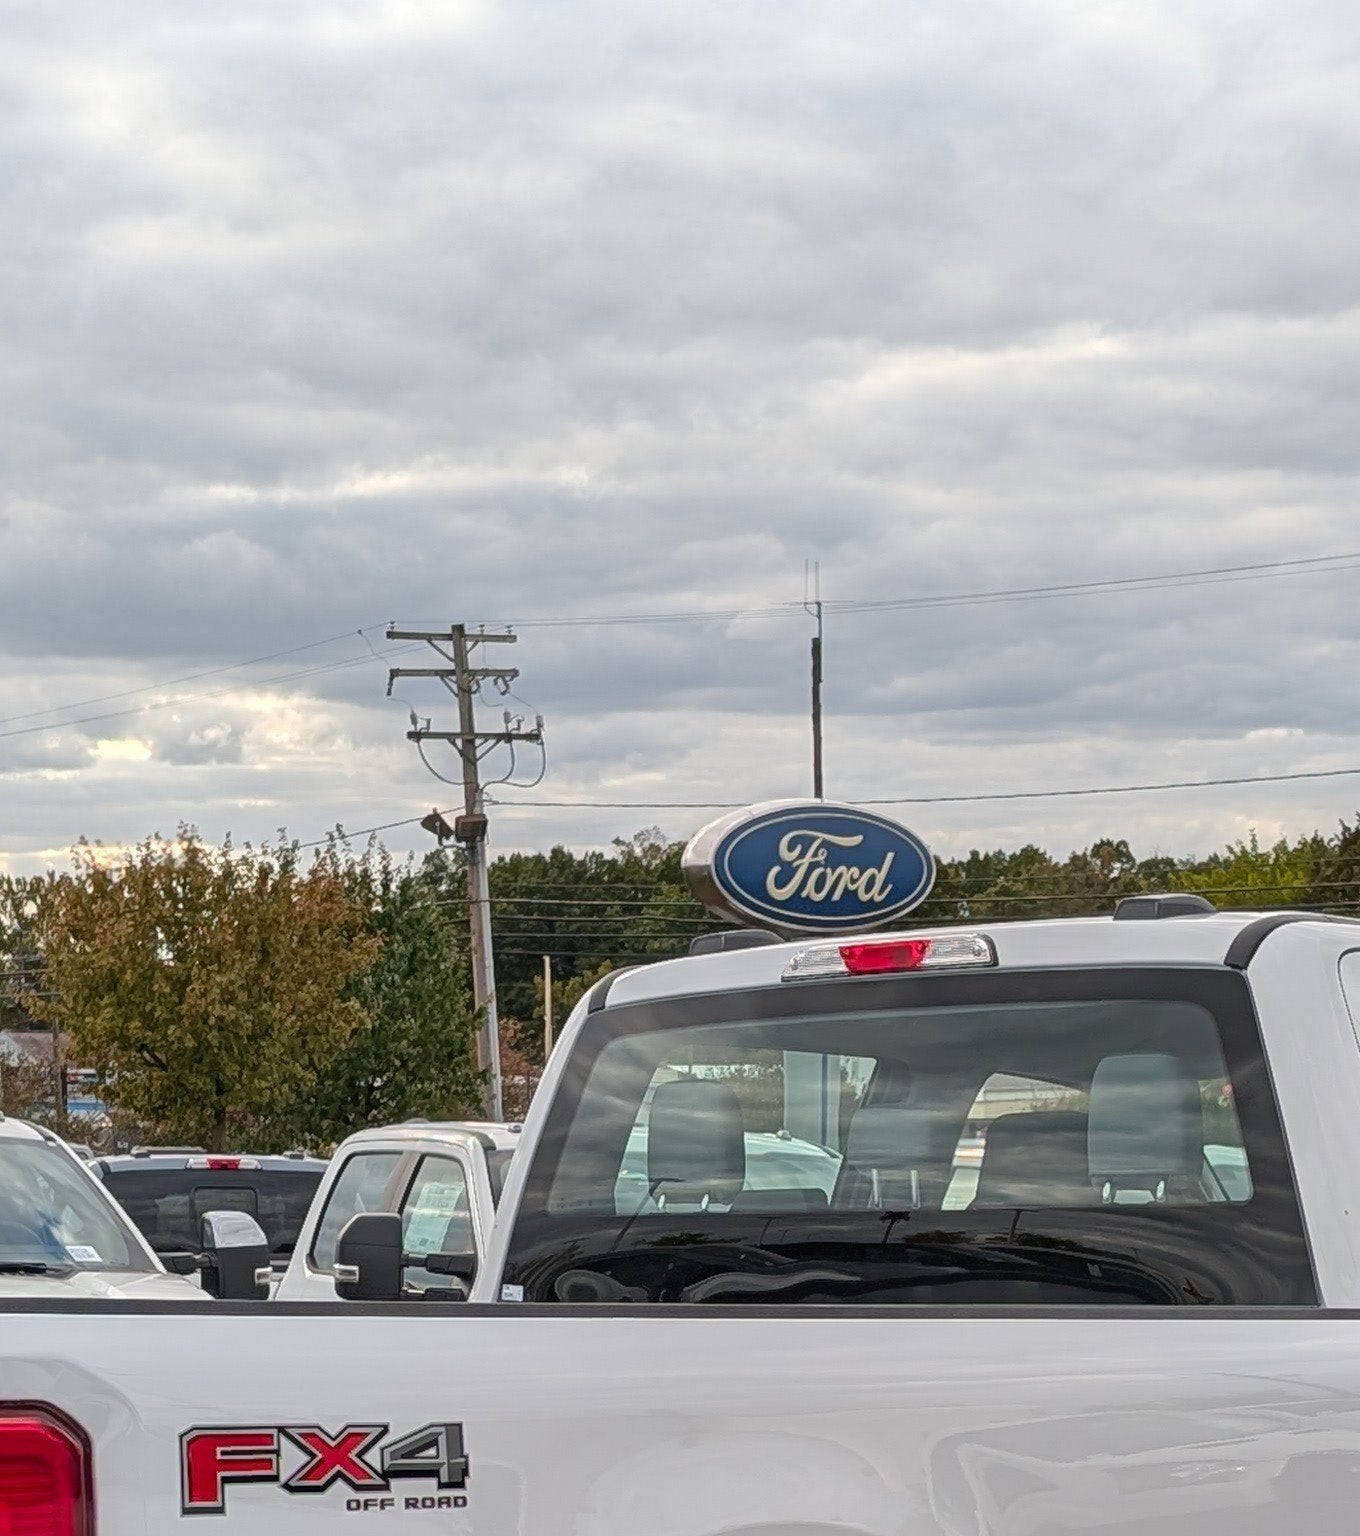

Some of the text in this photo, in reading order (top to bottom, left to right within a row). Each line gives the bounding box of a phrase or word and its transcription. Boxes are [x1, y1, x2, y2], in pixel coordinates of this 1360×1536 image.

[766, 830, 894, 902] Ford
[179, 1422, 471, 1518] FX4
[346, 1496, 469, 1512] OFF ROAD
